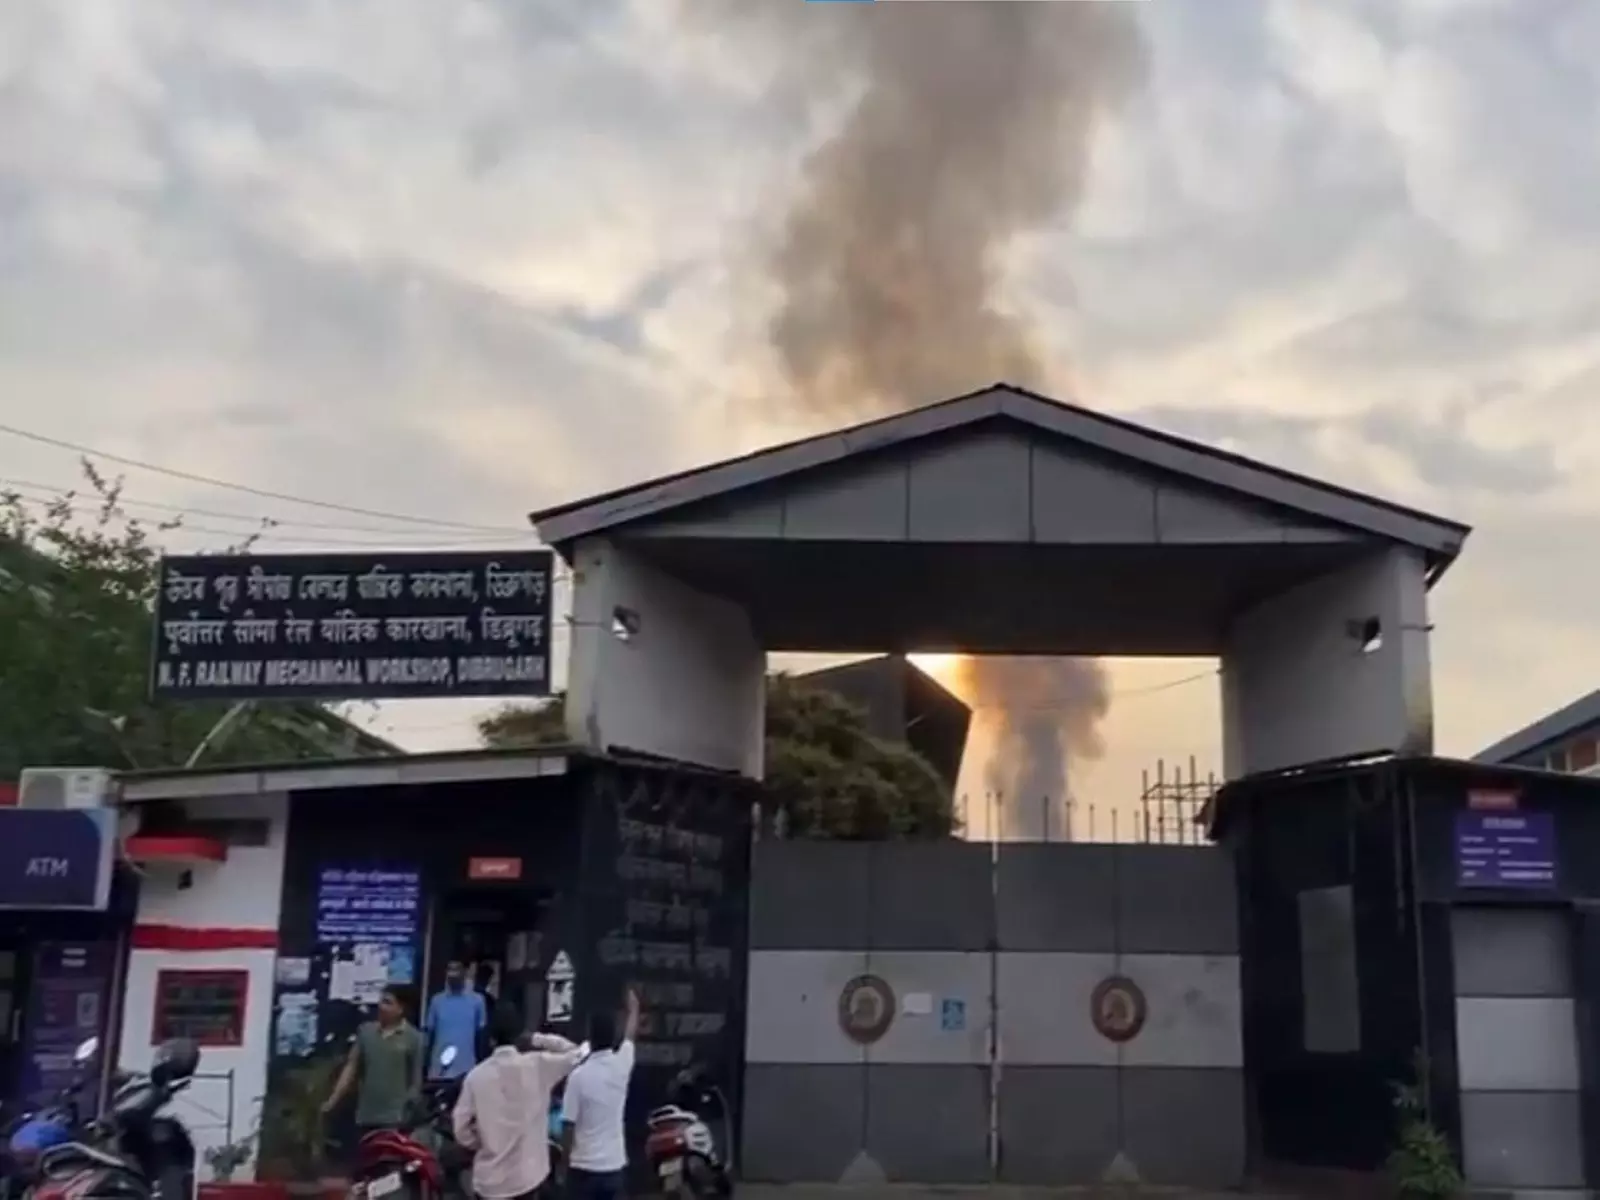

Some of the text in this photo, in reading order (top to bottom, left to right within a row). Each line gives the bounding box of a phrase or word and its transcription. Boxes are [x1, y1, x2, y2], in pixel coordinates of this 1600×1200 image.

[232, 608, 278, 644] सीमा
[284, 609, 314, 645] रेल
[320, 608, 380, 643] यांत्रिक
[385, 616, 473, 643] कारखाना,
[195, 660, 262, 686] RAILWAY
[265, 658, 362, 685] MECHANICAL
[366, 656, 454, 688] WORKSHOP,
[457, 655, 545, 683] DIBRUGARH
[25, 857, 69, 877] ATM
